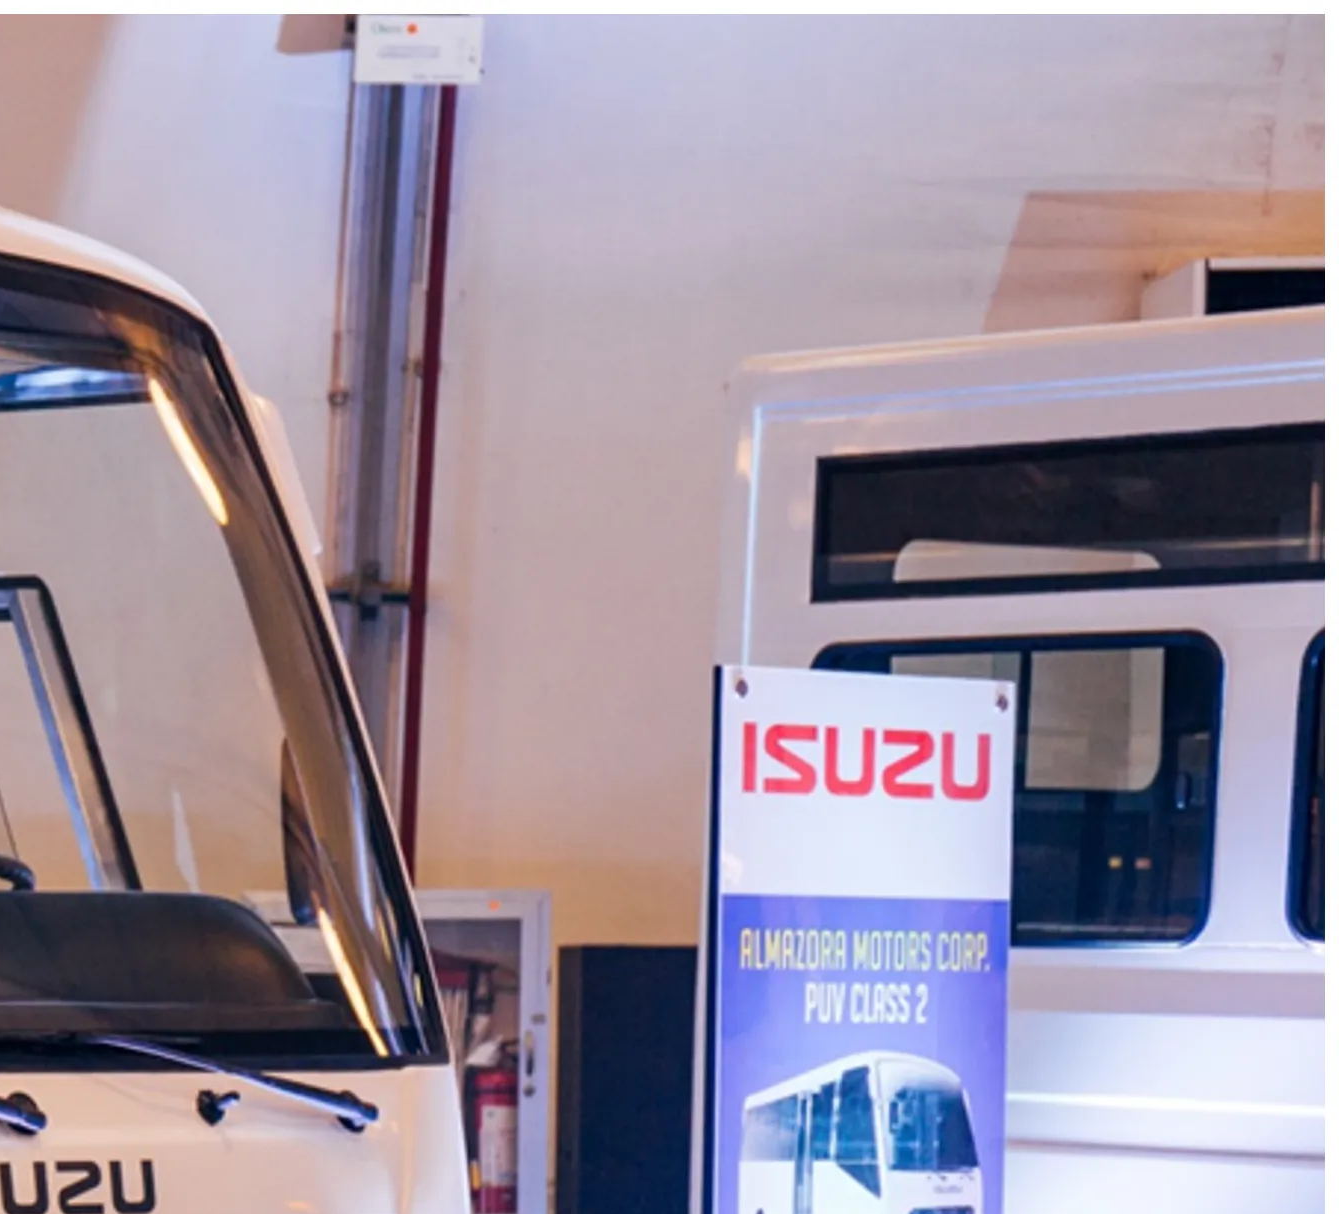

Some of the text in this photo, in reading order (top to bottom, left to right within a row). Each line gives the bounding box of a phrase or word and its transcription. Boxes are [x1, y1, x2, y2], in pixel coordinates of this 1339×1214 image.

[741, 722, 992, 803] ISUZU
[740, 928, 991, 972] ALMAZORA MOTORS CORP.
[804, 982, 928, 1025] PUV CLASS 2
